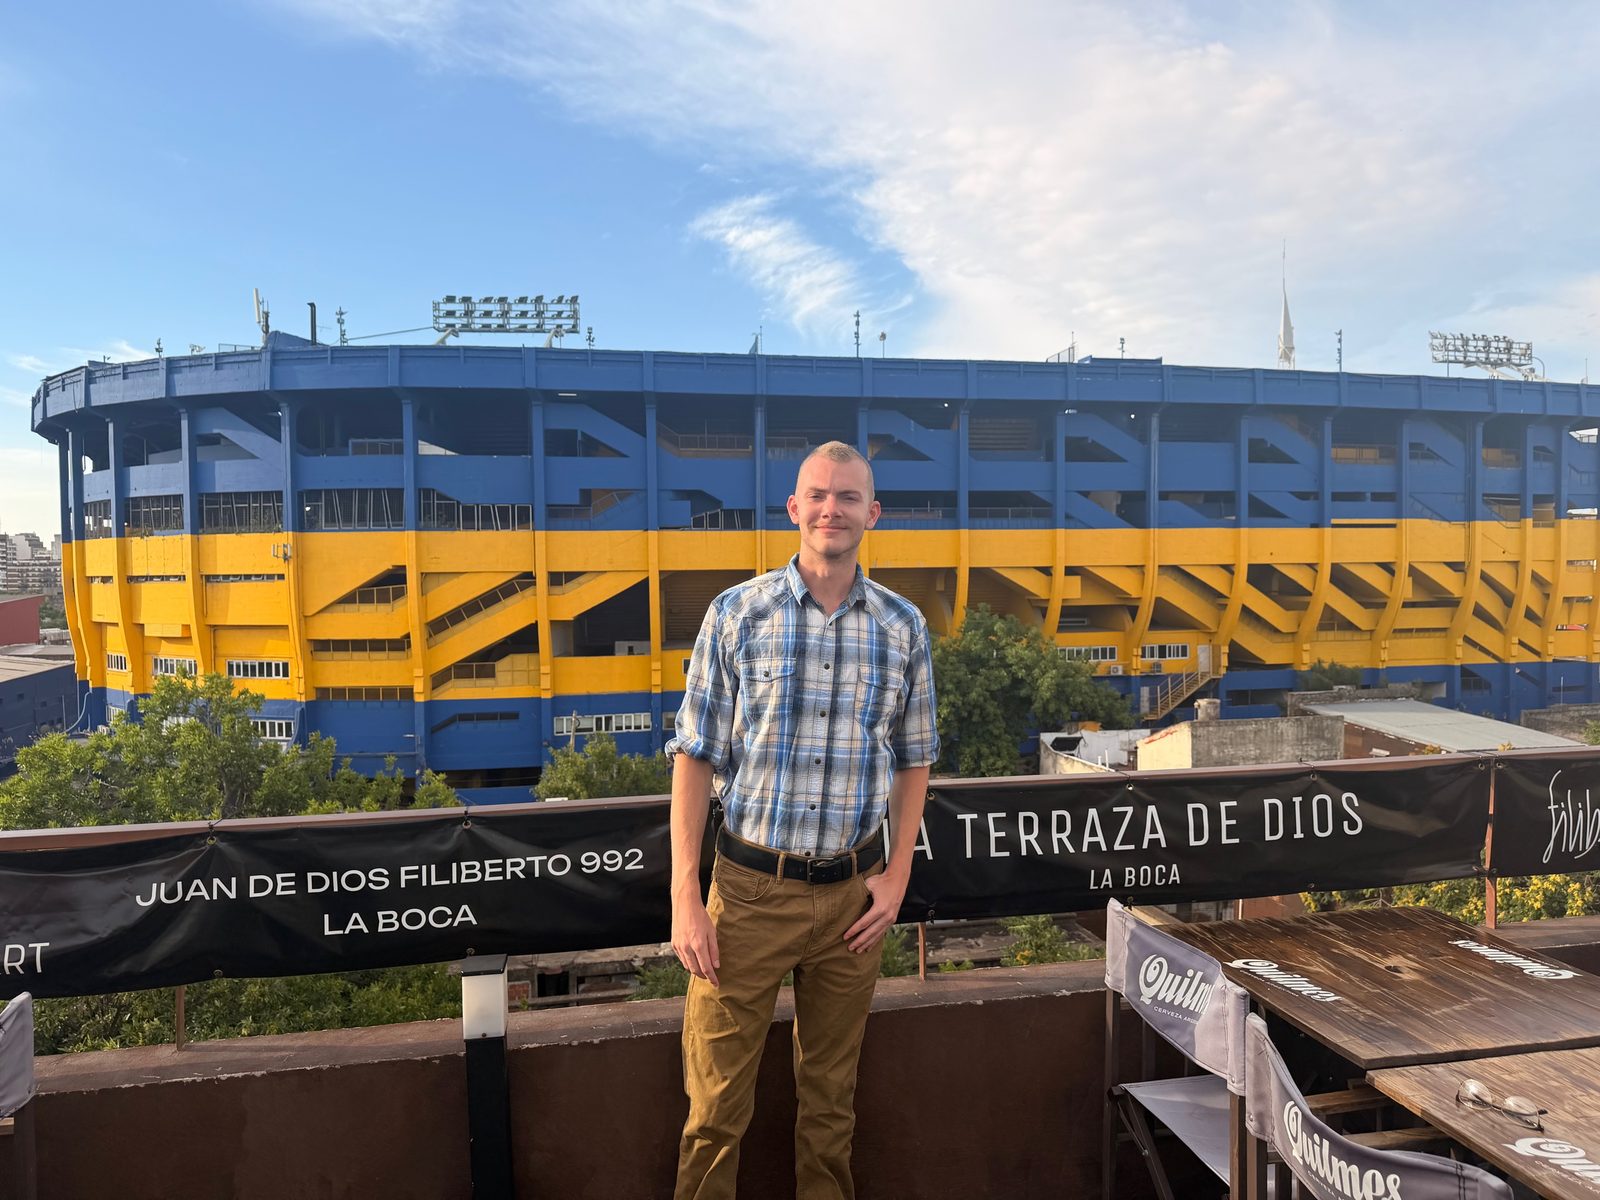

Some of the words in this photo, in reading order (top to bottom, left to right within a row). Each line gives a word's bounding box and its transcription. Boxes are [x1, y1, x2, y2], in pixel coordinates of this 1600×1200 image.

[956, 804, 1168, 859] TERRAZA
[1186, 800, 1240, 847] DE
[1262, 792, 1364, 842] DIOS
[1542, 769, 1600, 864] filib
[135, 876, 237, 908] JUAN
[248, 872, 296, 899] DE
[306, 867, 390, 895] DIOS
[399, 853, 572, 889] FILIBERTO
[580, 848, 645, 874] 992
[1089, 868, 1114, 890] LA
[1123, 863, 1181, 888] BOCA
[323, 911, 370, 937] LA
[376, 904, 478, 934] BOCA
[0, 942, 50, 975] RT
[1222, 958, 1343, 1002] Quilmes
[1283, 1100, 1402, 1200] Quilmes
